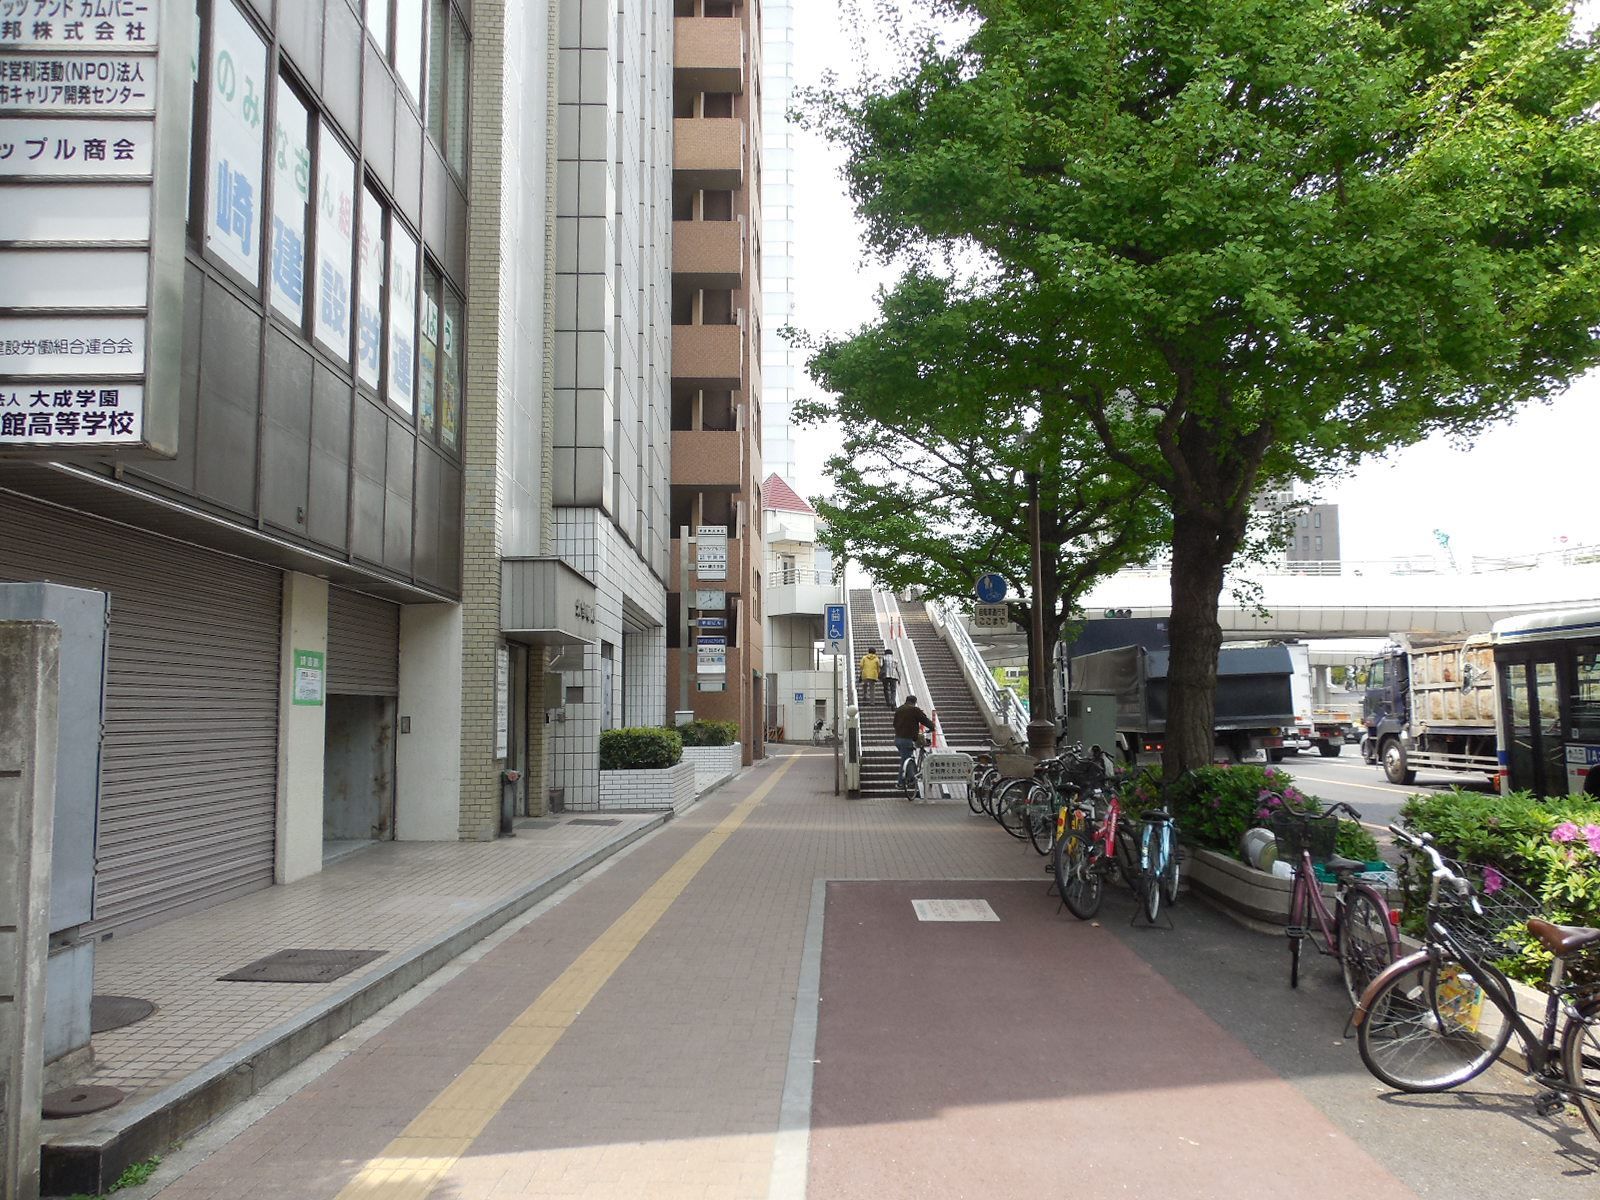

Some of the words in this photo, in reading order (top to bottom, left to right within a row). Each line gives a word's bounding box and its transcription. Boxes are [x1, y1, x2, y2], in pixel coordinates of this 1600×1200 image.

[2, 21, 146, 41] 邦株式会社
[0, 85, 145, 104] 市キャリア開発センター
[29, 389, 119, 408] 大成学園
[979, 617, 1005, 625] ここまで
